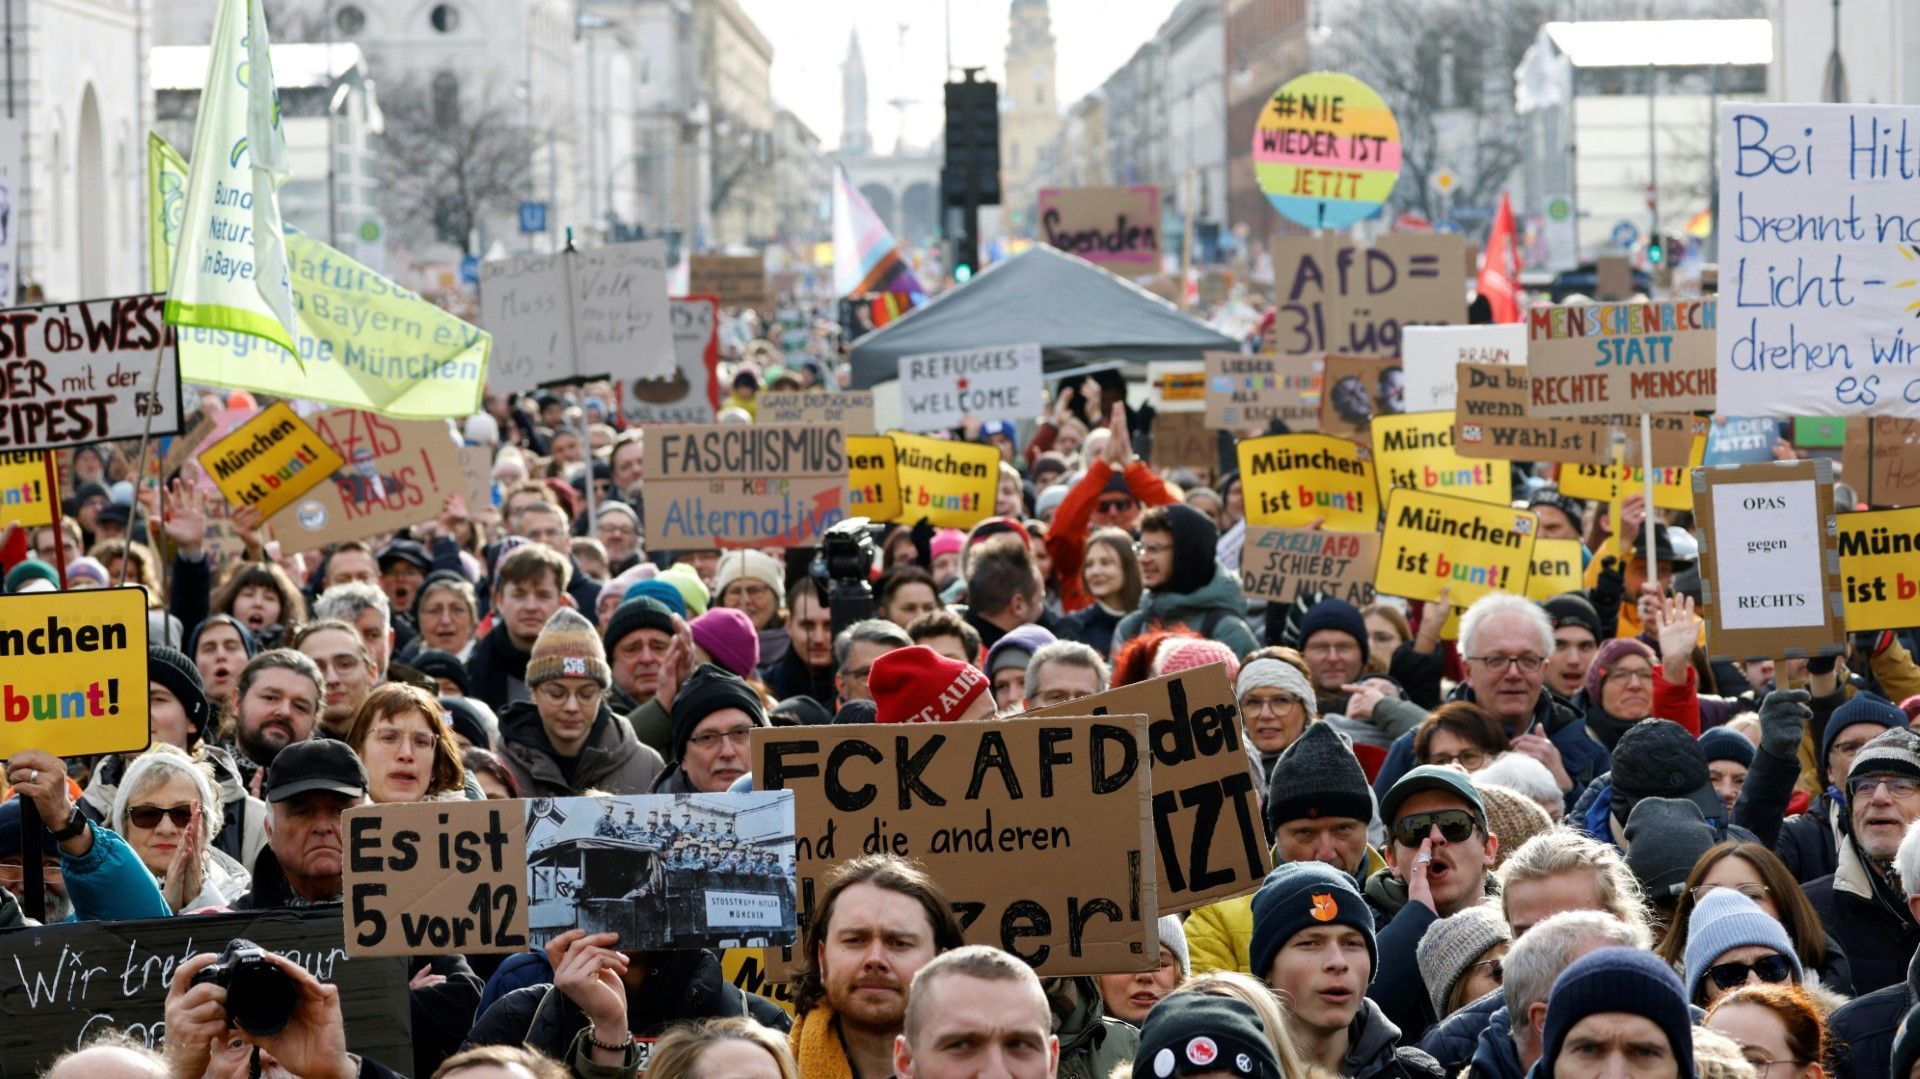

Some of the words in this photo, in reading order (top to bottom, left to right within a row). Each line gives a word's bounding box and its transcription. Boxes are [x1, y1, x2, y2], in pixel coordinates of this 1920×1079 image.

[1273, 92, 1344, 123] #NIE
[1261, 125, 1340, 159] WIEDER
[1350, 132, 1388, 163] IST
[1734, 114, 1813, 177] Bei
[1291, 167, 1363, 200] JETZT
[1736, 191, 1865, 244] brennt
[1594, 336, 1674, 366] STATT
[1731, 318, 1853, 370] drehen
[62, 364, 96, 393] mit
[106, 362, 141, 388] der
[344, 342, 478, 381] München
[910, 350, 1019, 381] REFUGEES
[1469, 367, 1500, 388] Du
[908, 387, 1021, 419] WELCOME
[1532, 373, 1610, 407] RECHTE
[1836, 374, 1880, 405] es
[213, 417, 298, 482] München
[662, 426, 843, 475] FASCHISMUS
[1251, 449, 1366, 477] München
[261, 443, 320, 492] bunt!
[1390, 467, 1418, 490] ist
[1424, 463, 1493, 488] bunt!
[741, 477, 790, 496] keine
[917, 484, 980, 512] bunt!
[1261, 491, 1291, 515] ist
[1299, 485, 1364, 513] bunt!
[662, 494, 847, 541] Alternative
[1743, 496, 1787, 511] OPAS
[1397, 505, 1522, 550] München
[1747, 537, 1787, 554] gegen
[1264, 552, 1352, 579] SCHIEBT
[1396, 547, 1428, 576] ist
[1435, 553, 1510, 590] bunt!
[1243, 571, 1286, 597] DEN
[1846, 576, 1887, 603] ist
[1896, 572, 1920, 600] b
[1737, 594, 1806, 610] RECHTS
[4, 678, 121, 724] bunt!
[1148, 677, 1240, 768] der
[762, 733, 947, 814] FCK
[964, 724, 1140, 802] AFD
[349, 815, 420, 874] Es
[438, 810, 509, 873] ist
[863, 815, 909, 857] die
[931, 808, 1071, 855] anderen
[351, 883, 388, 948] 5
[402, 912, 475, 949] vor
[468, 882, 526, 948] 12
[13, 943, 108, 1009] Wir
